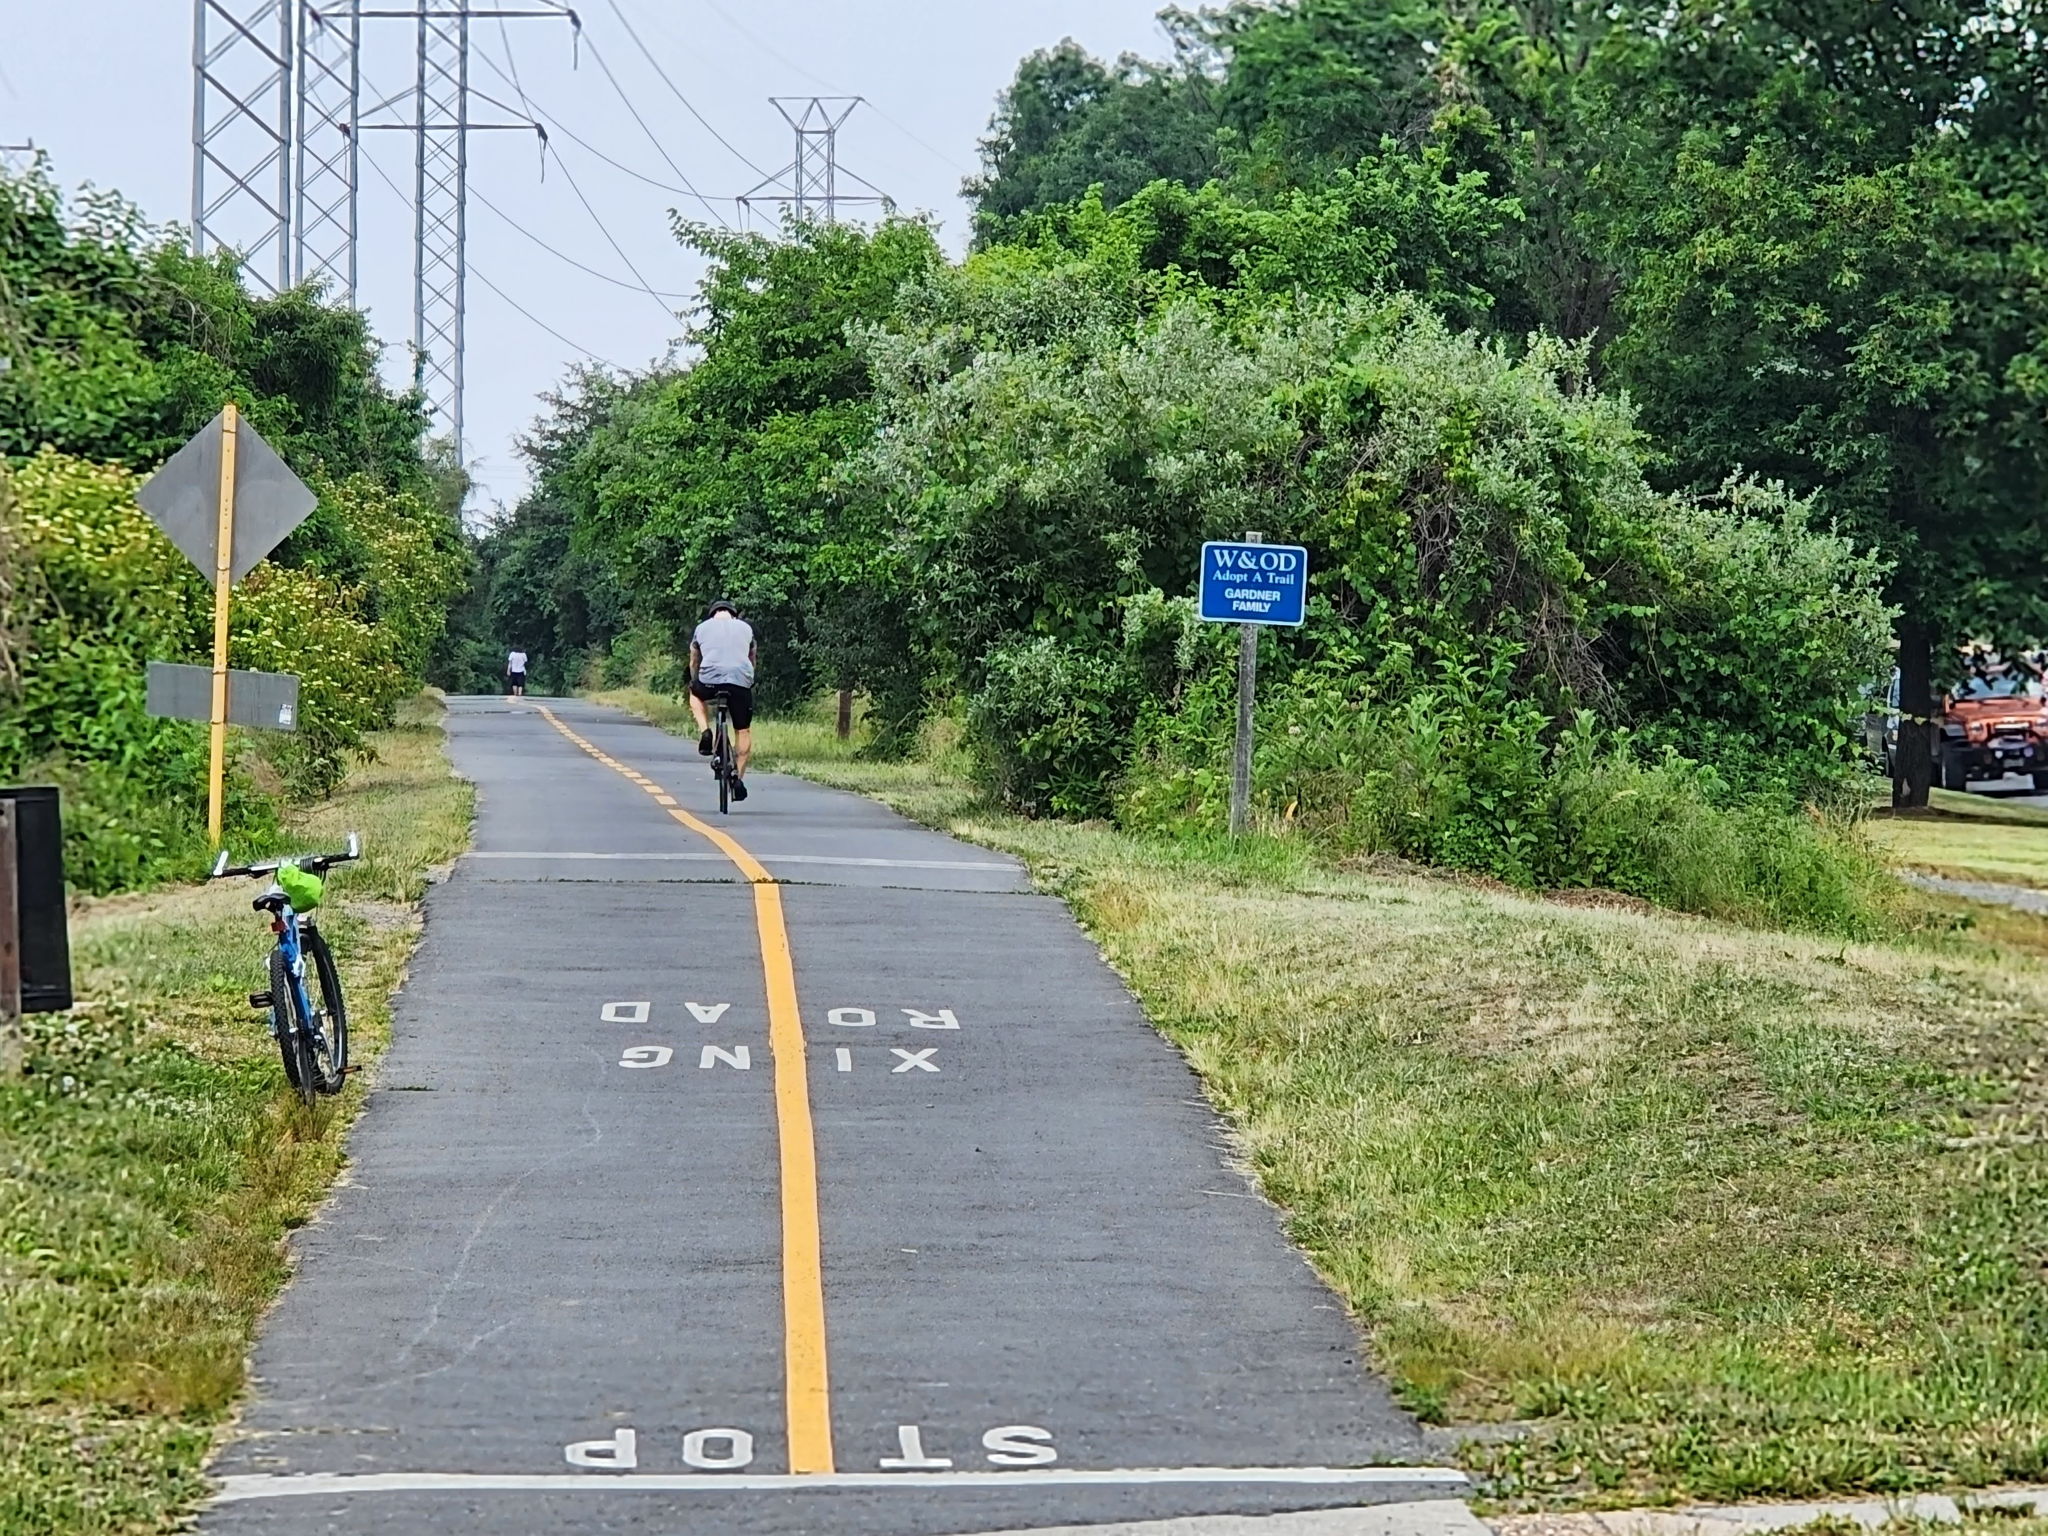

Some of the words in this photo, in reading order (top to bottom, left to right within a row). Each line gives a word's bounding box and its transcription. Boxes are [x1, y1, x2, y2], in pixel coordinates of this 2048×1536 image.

[1213, 549, 1296, 571] W&OD
[1212, 570, 1248, 583] Adopt
[1252, 572, 1262, 582] A
[1266, 572, 1294, 585] Trail
[1224, 588, 1281, 601] GARDNER
[1232, 601, 1271, 613] FAMILY
